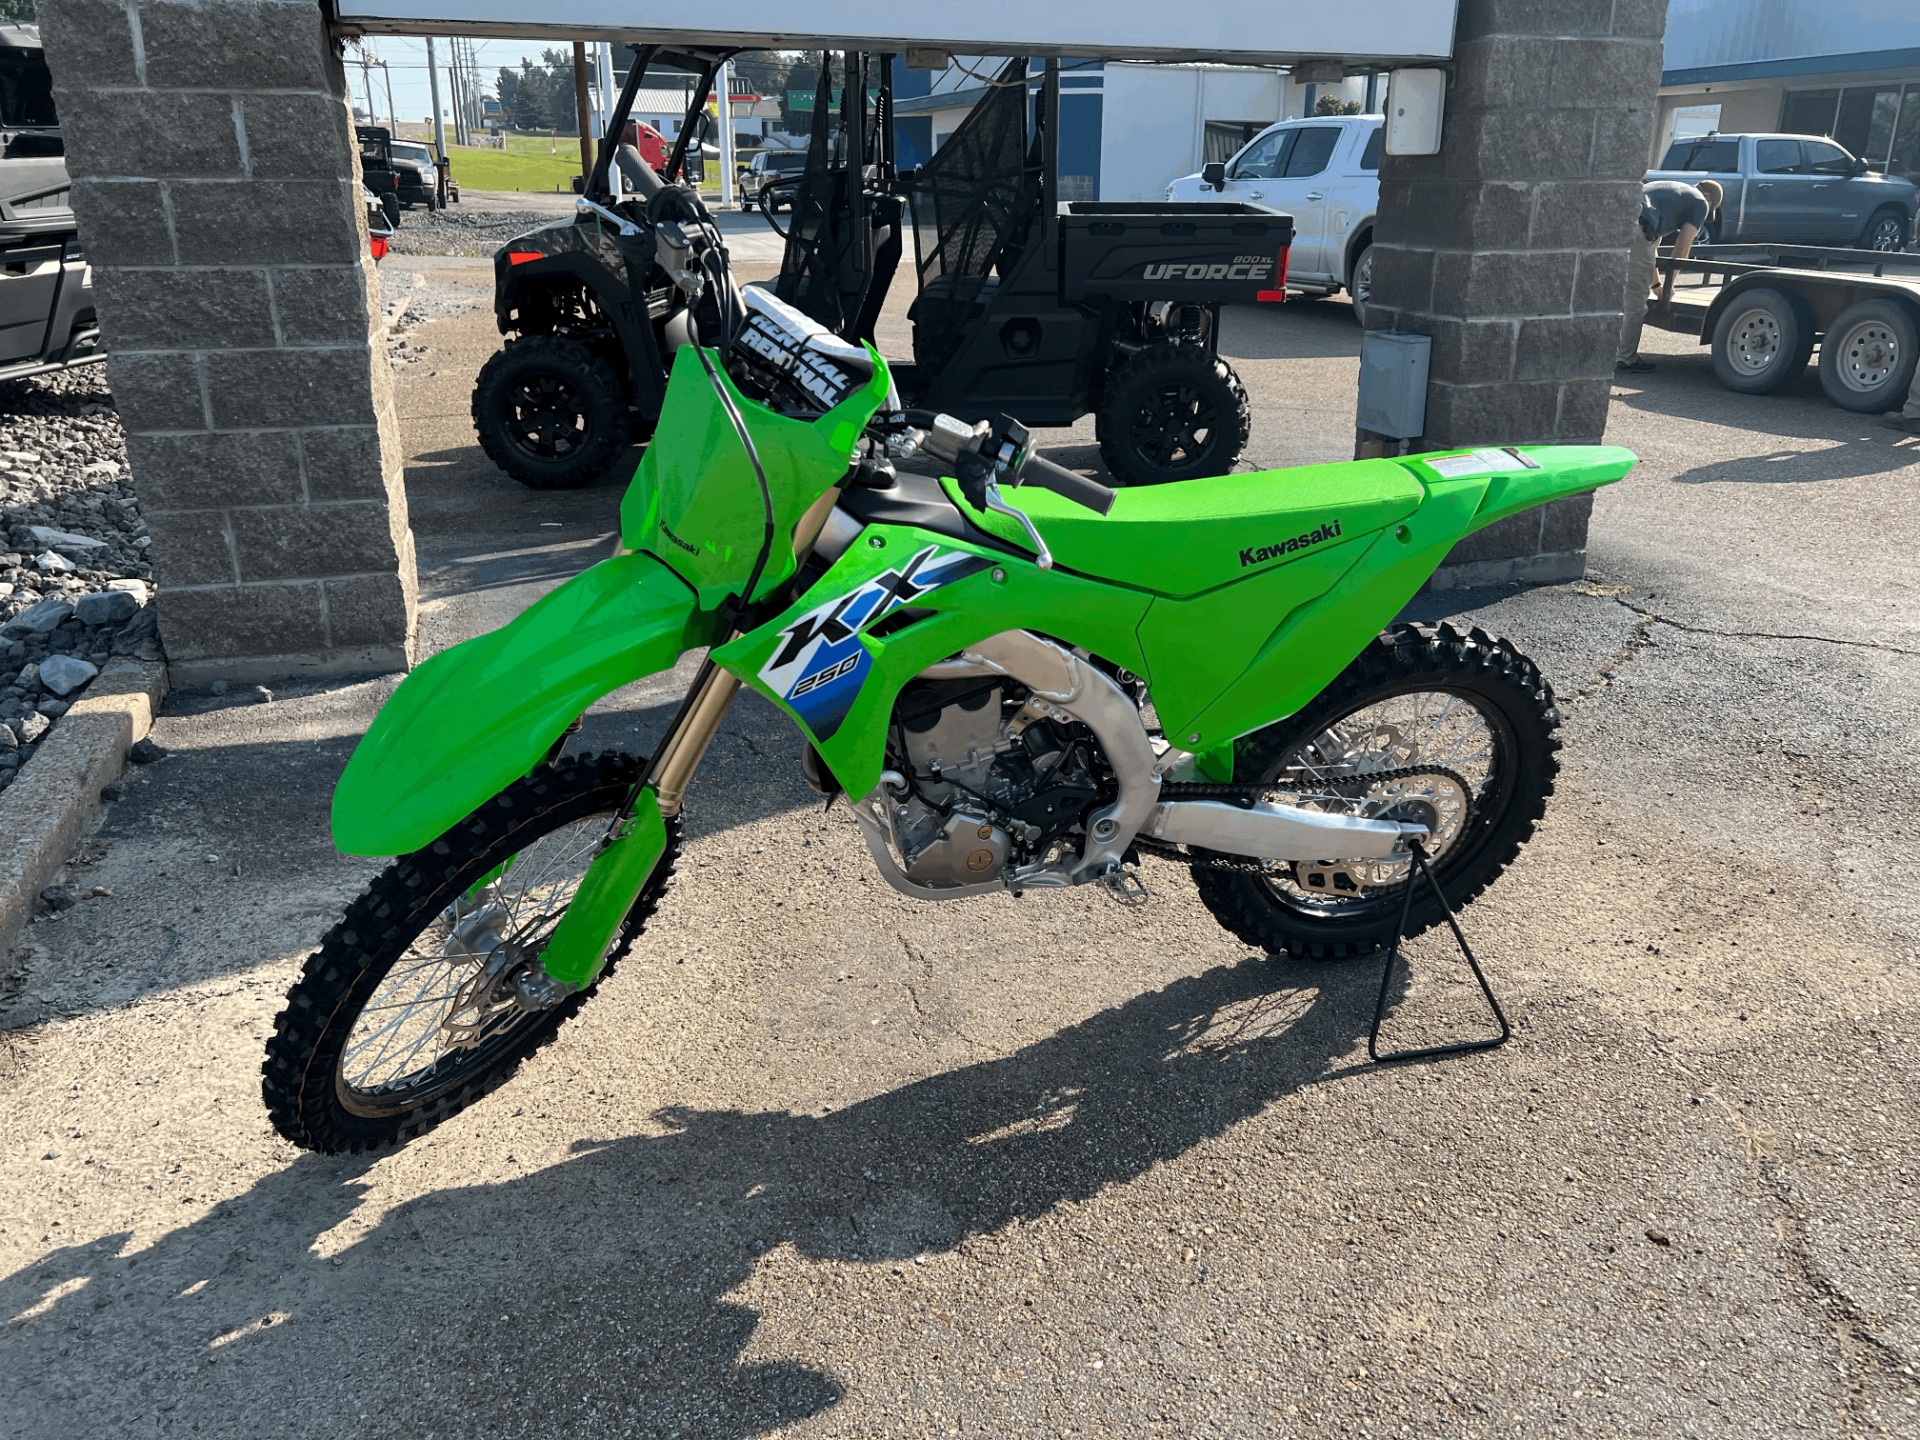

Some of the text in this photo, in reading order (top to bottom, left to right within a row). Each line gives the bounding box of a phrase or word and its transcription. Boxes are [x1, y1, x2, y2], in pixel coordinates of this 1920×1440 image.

[1143, 264, 1273, 280] UFORCE
[750, 315, 850, 390] RENHAL
[659, 518, 701, 556] Kawasaki
[1239, 519, 1342, 567] Kawasaki
[768, 545, 940, 672] KX
[790, 650, 862, 699] 250
